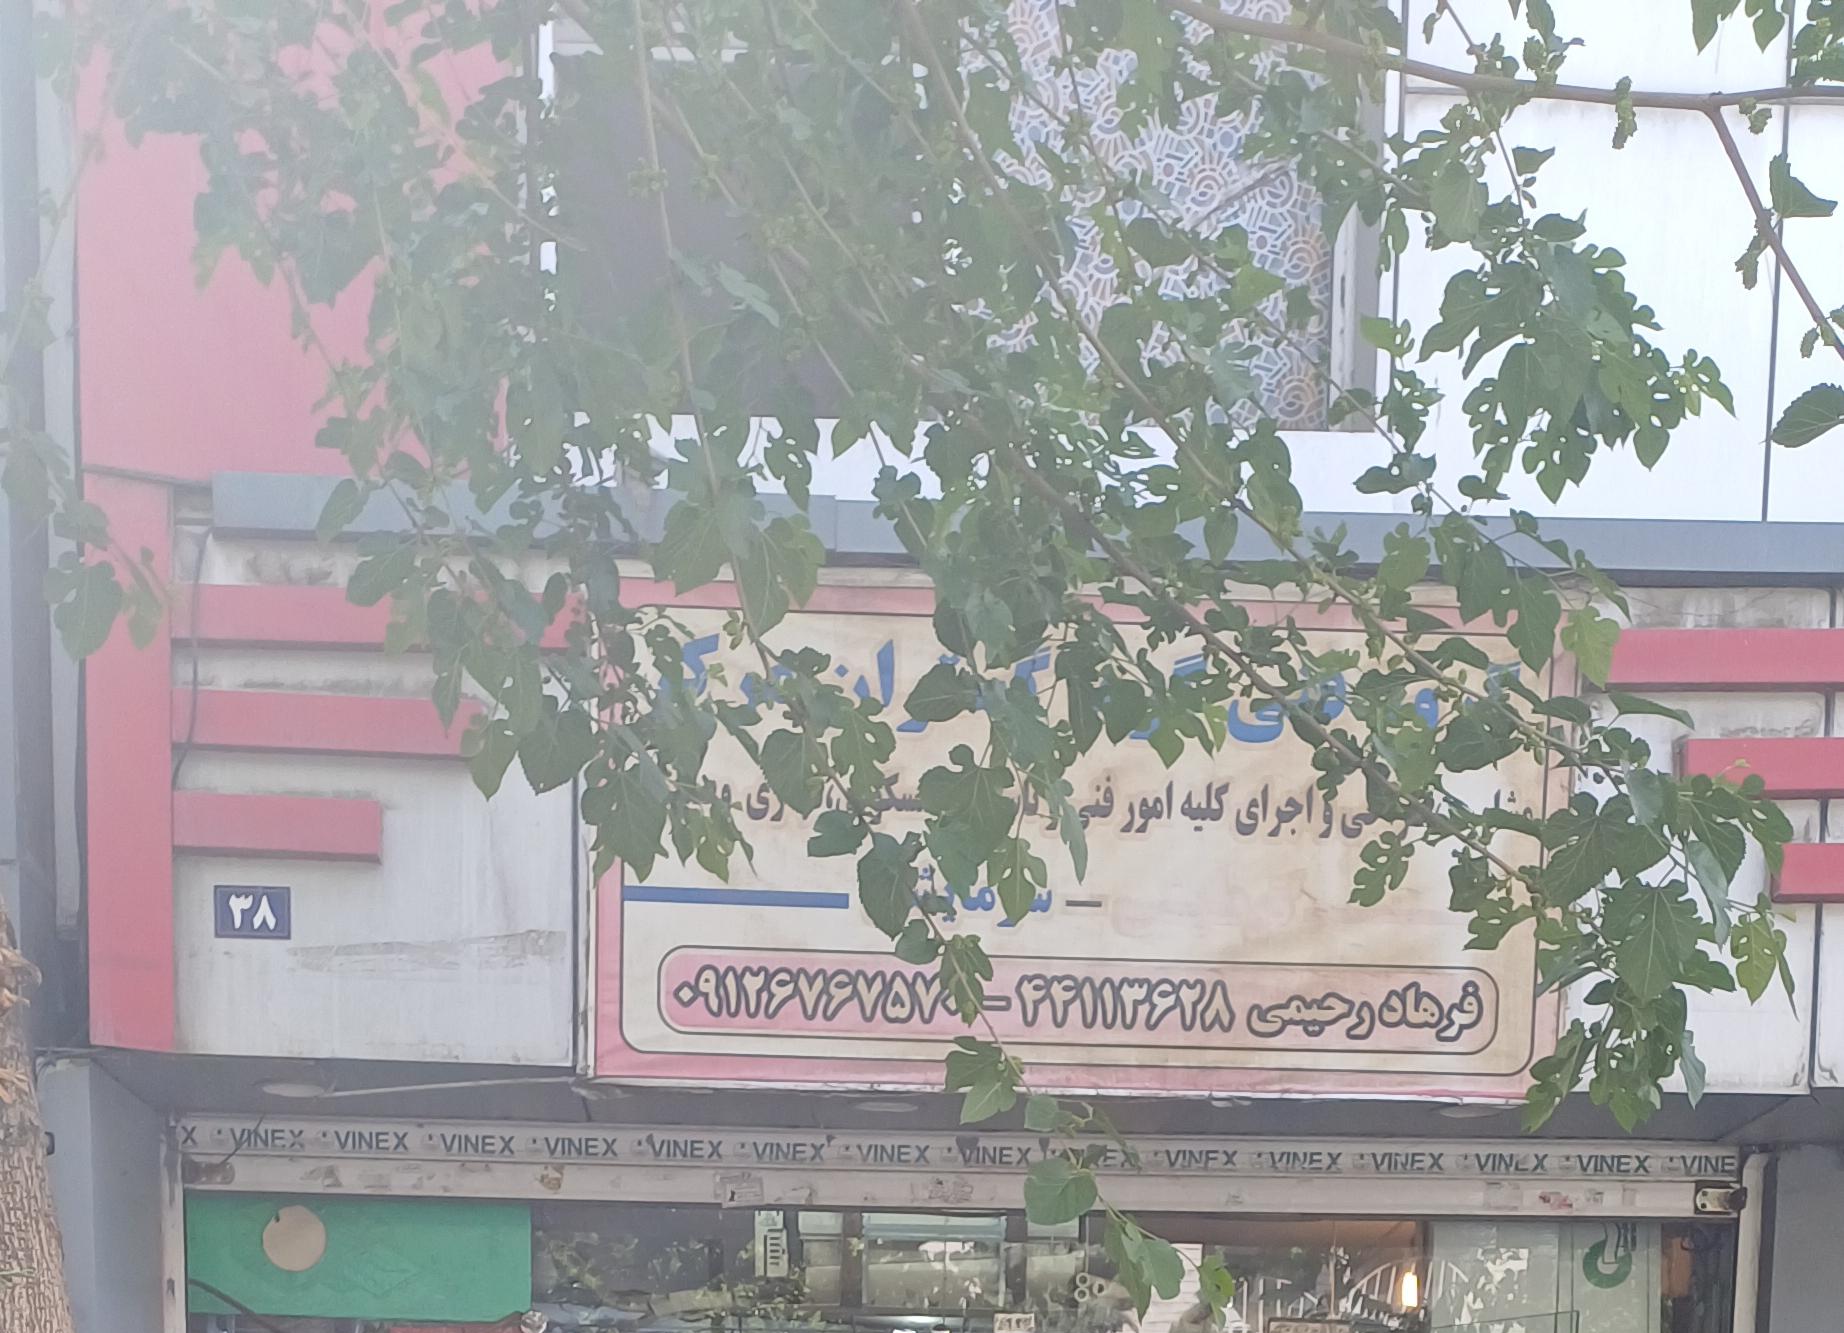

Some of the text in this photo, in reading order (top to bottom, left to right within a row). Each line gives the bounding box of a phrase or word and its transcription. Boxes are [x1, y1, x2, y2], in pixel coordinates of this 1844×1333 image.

[1119, 780, 1174, 834] امور
[1180, 781, 1231, 832] کلیه
[1235, 783, 1315, 838] اجرای
[228, 893, 277, 931] ۳۸
[1015, 973, 1236, 1032] ۴۴۱۱۳۶۲۸
[1247, 991, 1375, 1039] رحیمی
[1378, 980, 1484, 1041] فرهاد
[228, 1127, 305, 1150] VINEX
[334, 1130, 409, 1152] VINEX
[440, 1133, 515, 1155] VINEX
[544, 1136, 618, 1158] VINEX
[651, 1138, 724, 1160] VINEX
[752, 1141, 826, 1163] VINEX
[856, 1143, 931, 1165] VINEX
[960, 1146, 1032, 1167] VINEX
[1268, 1150, 1343, 1171] VINEX
[1371, 1152, 1444, 1172] VINEX
[1576, 1154, 1651, 1174] VINEX
[1680, 1155, 1737, 1175] VINE
